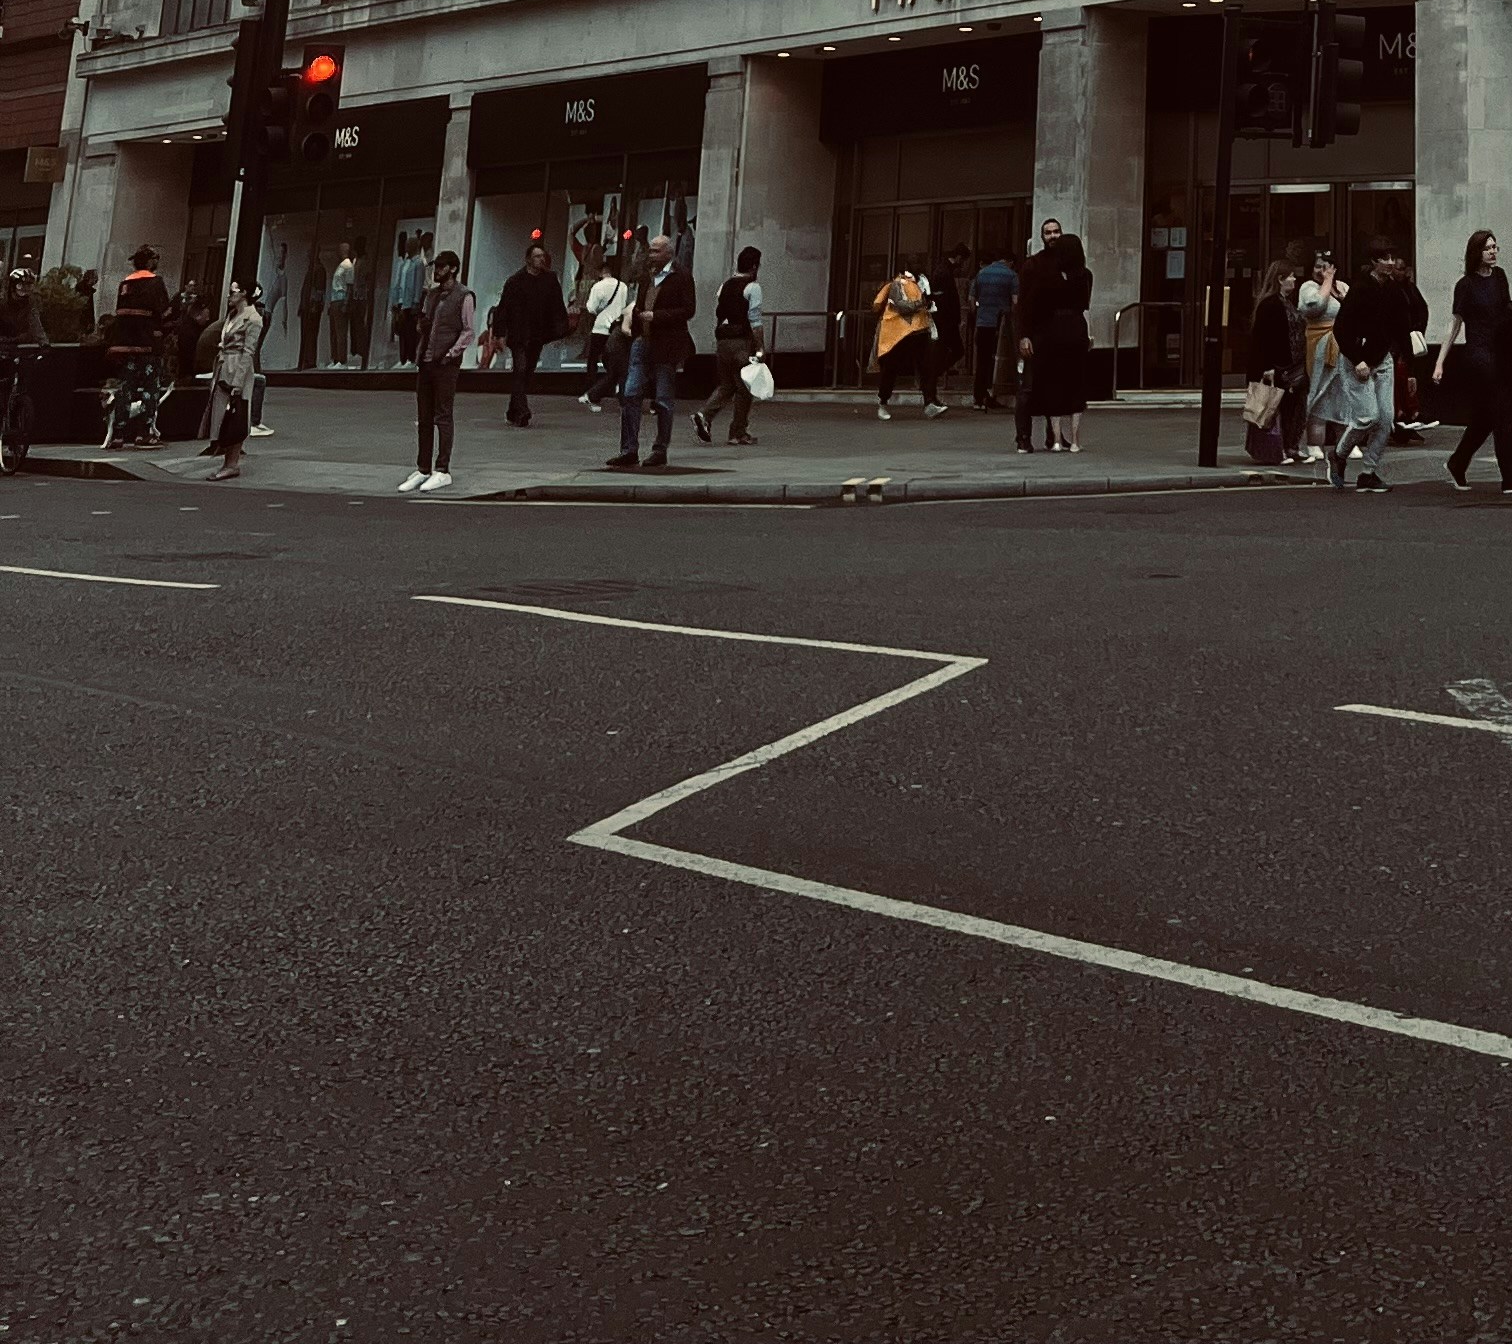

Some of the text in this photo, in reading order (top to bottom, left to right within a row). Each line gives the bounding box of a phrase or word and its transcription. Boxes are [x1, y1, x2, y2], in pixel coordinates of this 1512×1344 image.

[1378, 31, 1416, 61] M&
[942, 63, 980, 93] M&S
[564, 98, 596, 125] M&S
[334, 125, 360, 149] M&S
